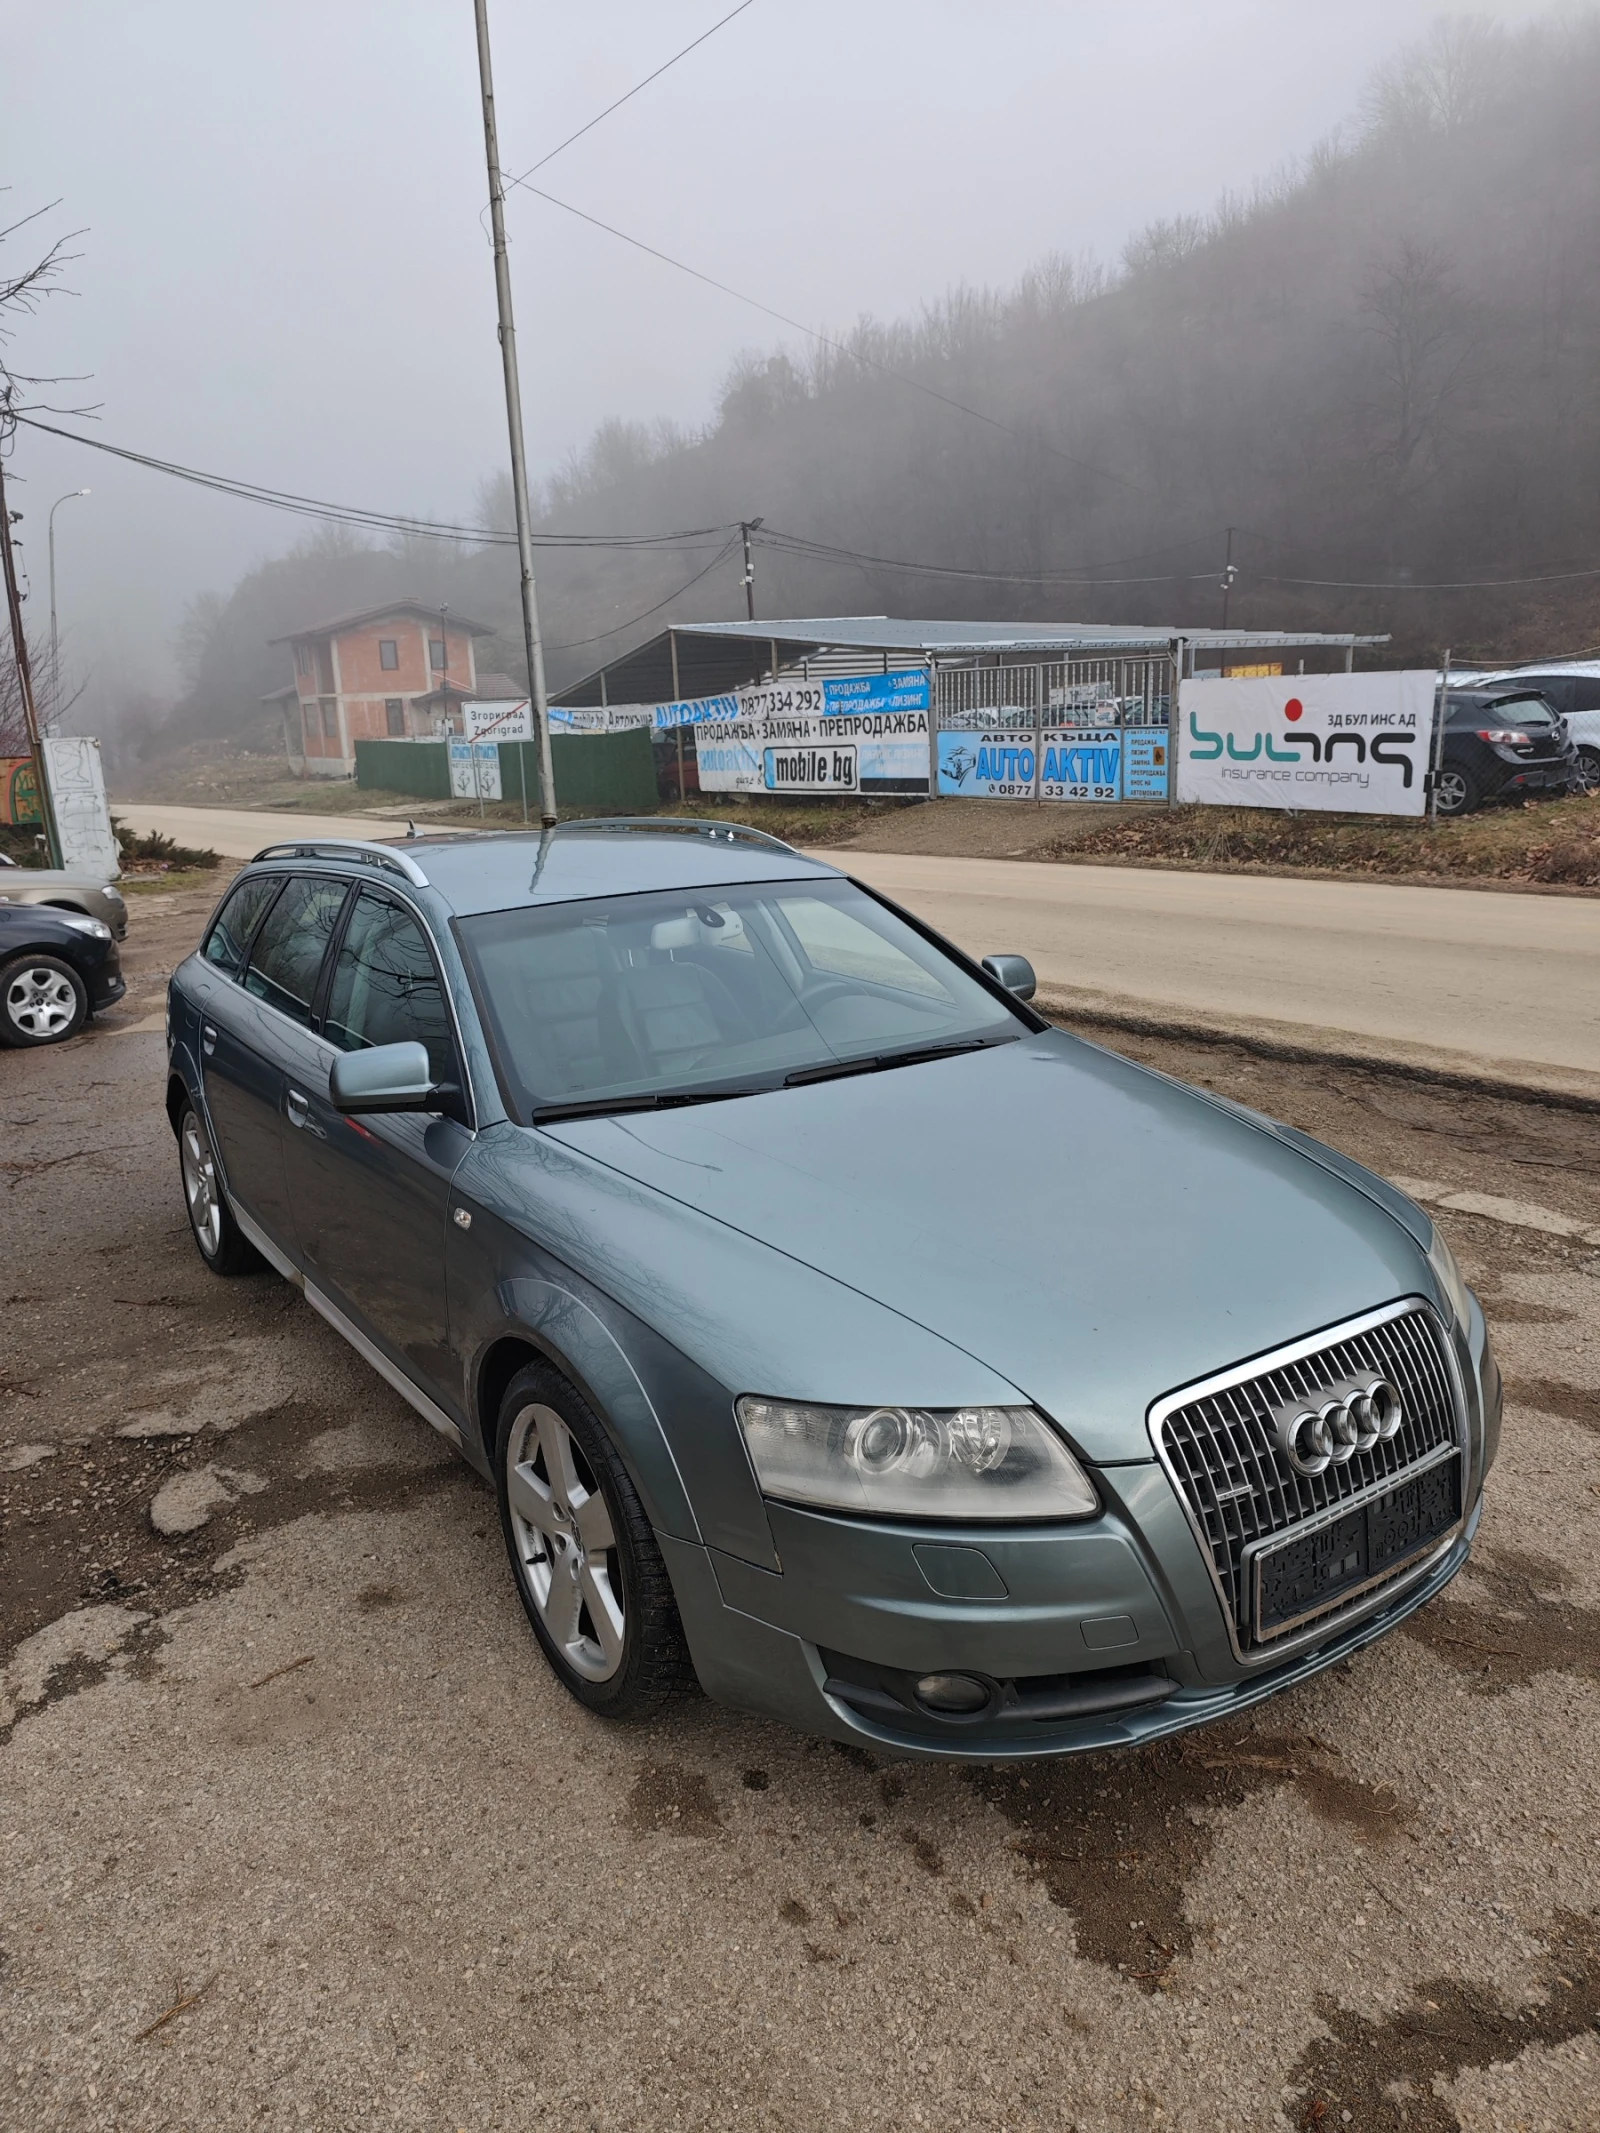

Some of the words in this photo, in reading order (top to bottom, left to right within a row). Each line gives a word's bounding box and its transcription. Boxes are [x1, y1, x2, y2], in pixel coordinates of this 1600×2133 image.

[829, 682, 870, 696] ПРОДАЖБА
[892, 675, 925, 689] ЗАМЯНА
[471, 711, 525, 721] Згориград
[656, 696, 739, 728] AUTOAKTIV
[770, 691, 793, 712] 334
[795, 690, 821, 710] 292
[1328, 715, 1342, 727] ЗД
[1345, 714, 1367, 726] БУЛ
[1371, 714, 1395, 726] ИНС
[1398, 714, 1416, 727] АД
[474, 724, 523, 737] Zgorigrad
[696, 723, 755, 743] ПРОДАЖБА
[762, 720, 810, 739] ЗАМЯНА
[820, 713, 927, 738] ПРЕПРОДАЖБА
[980, 734, 1033, 742] АВТО
[1044, 733, 1118, 742] КЪЩА
[976, 747, 1034, 782] AUTO
[1042, 747, 1120, 783] AKTIV
[1221, 767, 1290, 781] insurance
[1295, 771, 1370, 788] company
[999, 785, 1031, 796] 0877
[1045, 785, 1064, 796] 33
[1069, 786, 1088, 797] 42
[1094, 787, 1114, 798] 92
